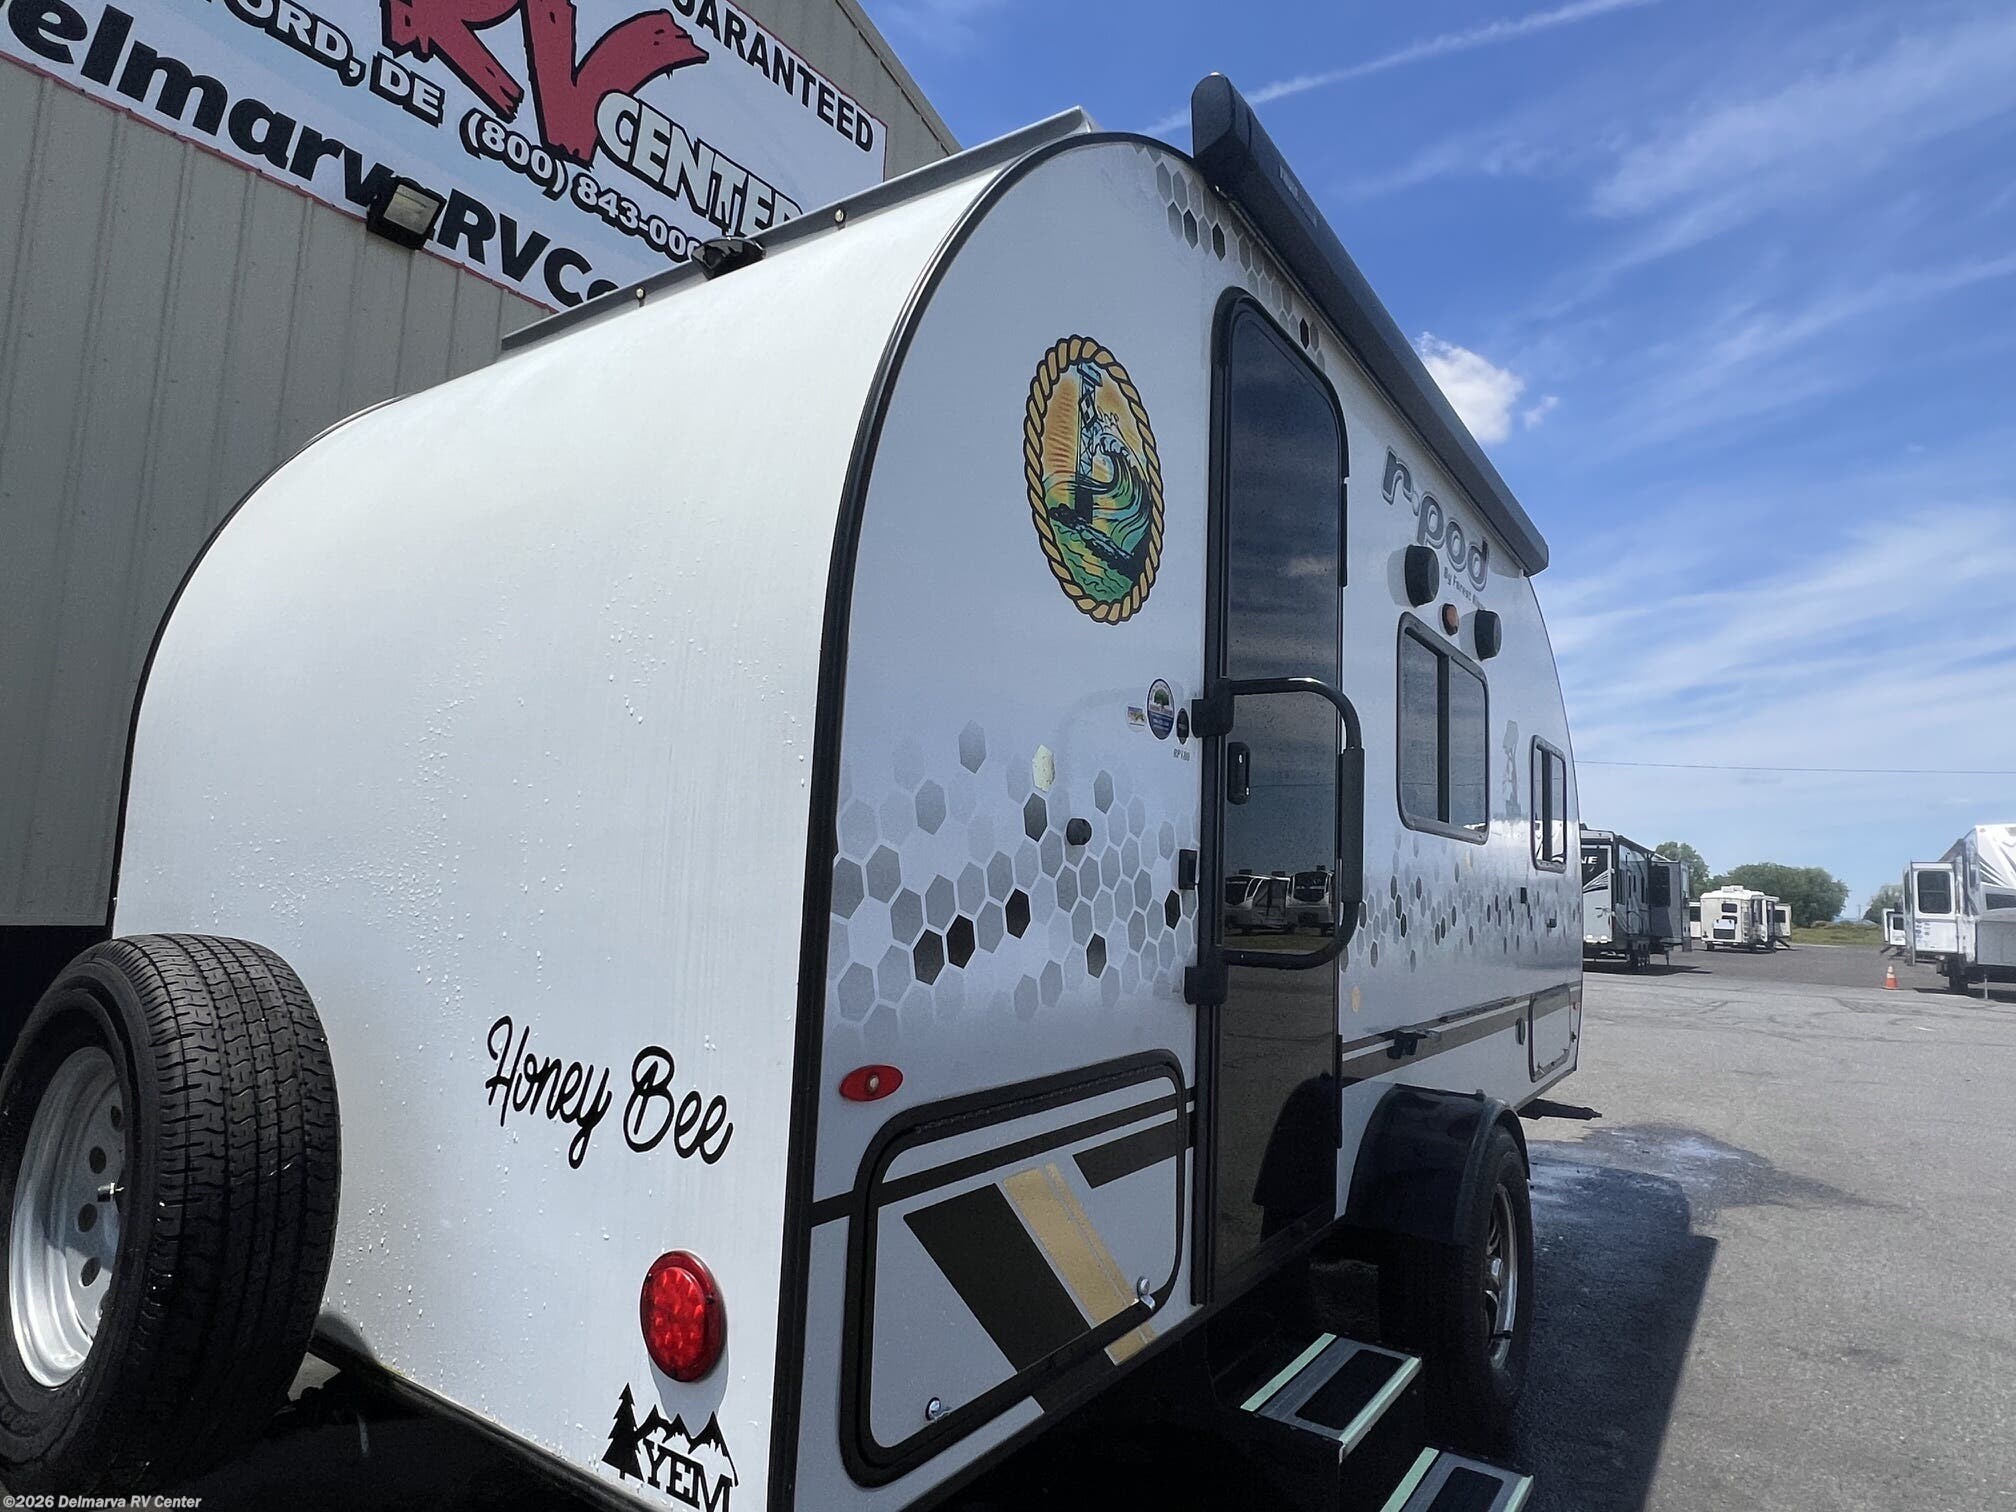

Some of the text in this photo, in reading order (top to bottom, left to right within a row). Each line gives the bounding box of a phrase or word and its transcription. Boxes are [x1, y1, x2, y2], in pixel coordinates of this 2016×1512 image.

[370, 52, 445, 128] DE
[461, 108, 568, 200] (800)
[485, 1015, 733, 1169] Honey Bee
